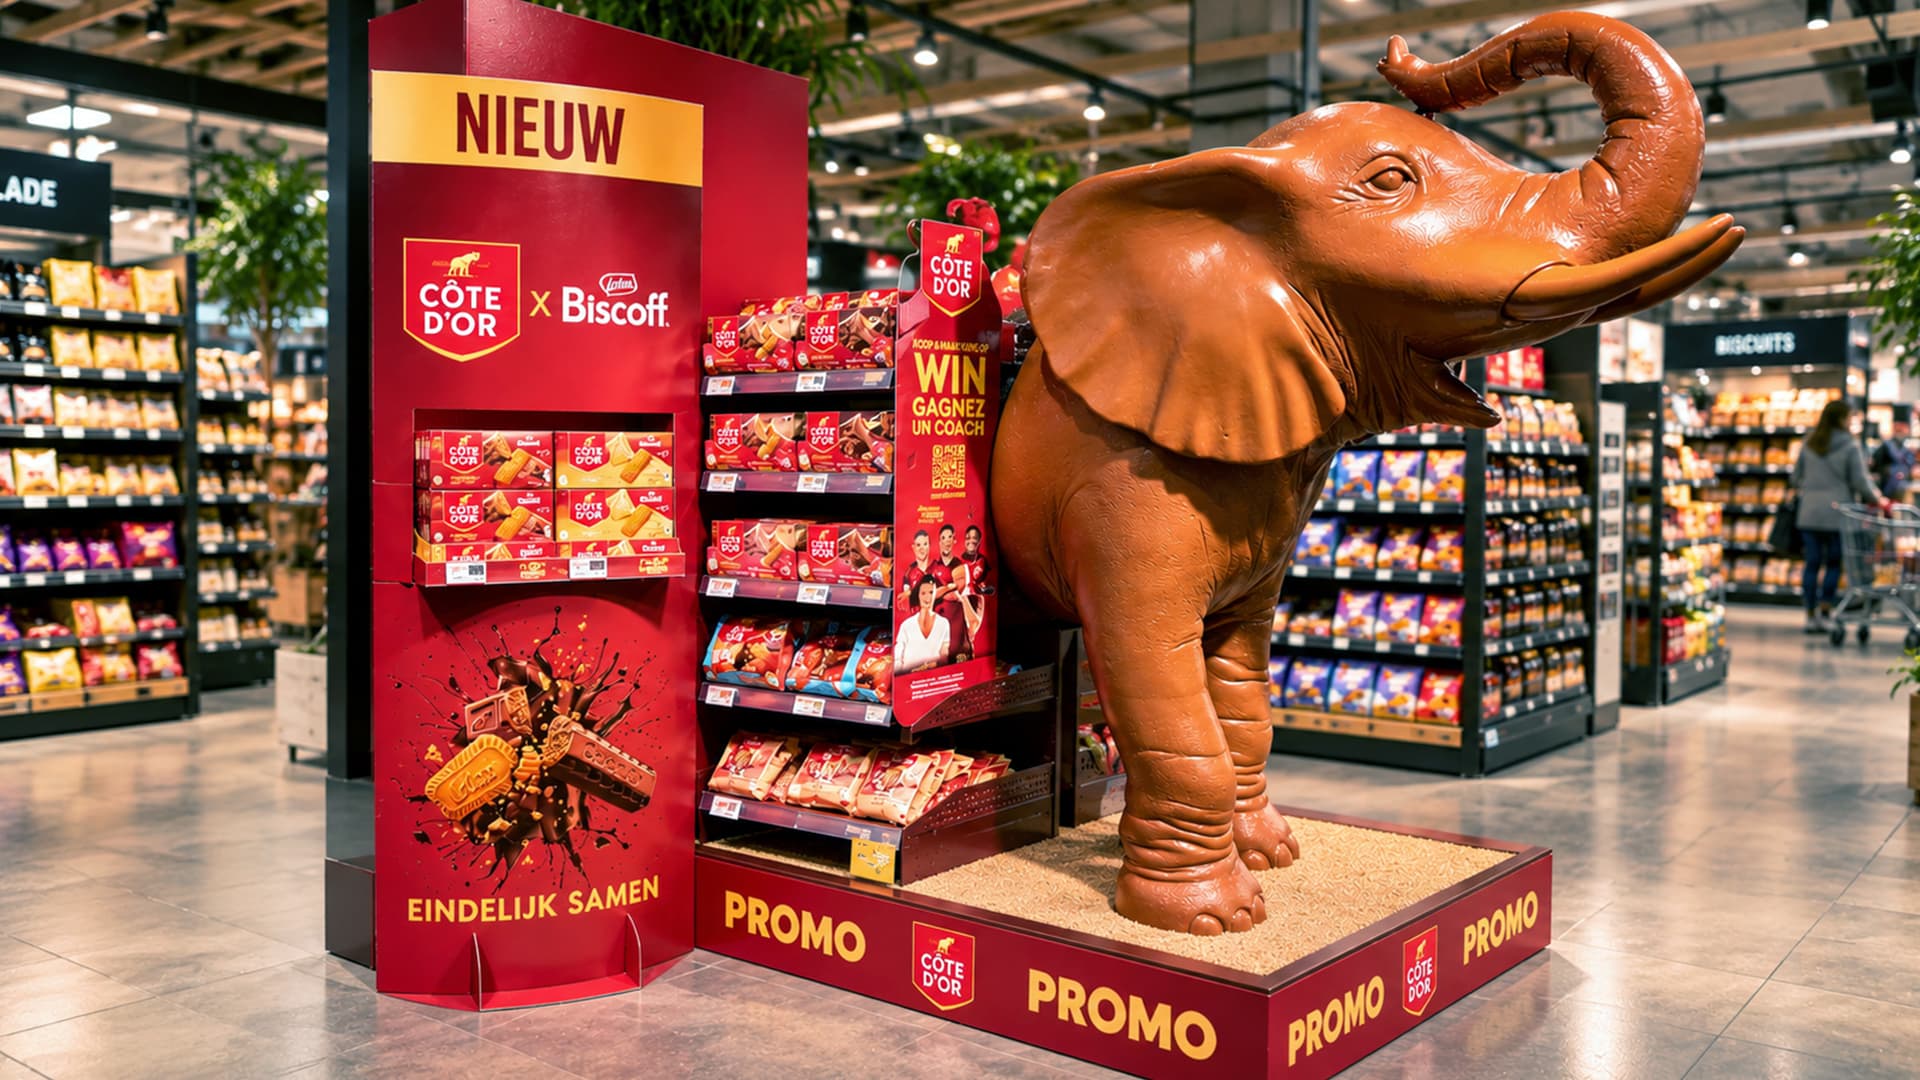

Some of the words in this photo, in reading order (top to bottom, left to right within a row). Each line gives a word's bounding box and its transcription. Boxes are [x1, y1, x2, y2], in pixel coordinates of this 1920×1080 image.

[456, 91, 626, 166] NIEUW
[930, 253, 973, 280] CÔTE
[418, 280, 502, 311] CÔTE
[933, 276, 971, 299] D'OR
[423, 311, 497, 338] D'OR
[1714, 331, 1796, 356] BISCUITS
[913, 352, 986, 396] WIN
[912, 396, 986, 418] GAGNEZ
[912, 419, 932, 437] UN
[934, 419, 985, 437] COACH
[407, 893, 558, 923] EINDELIJK
[568, 874, 660, 915] SAMEN
[724, 889, 867, 963] PROMO
[1463, 890, 1539, 966] PROMO
[920, 952, 965, 981] CÔTE
[1407, 957, 1433, 985] CÔTE
[923, 971, 962, 999] D'OR
[1408, 976, 1431, 1003] D'OR
[1027, 967, 1218, 1062] PROMO
[1287, 974, 1385, 1068] PROMO
